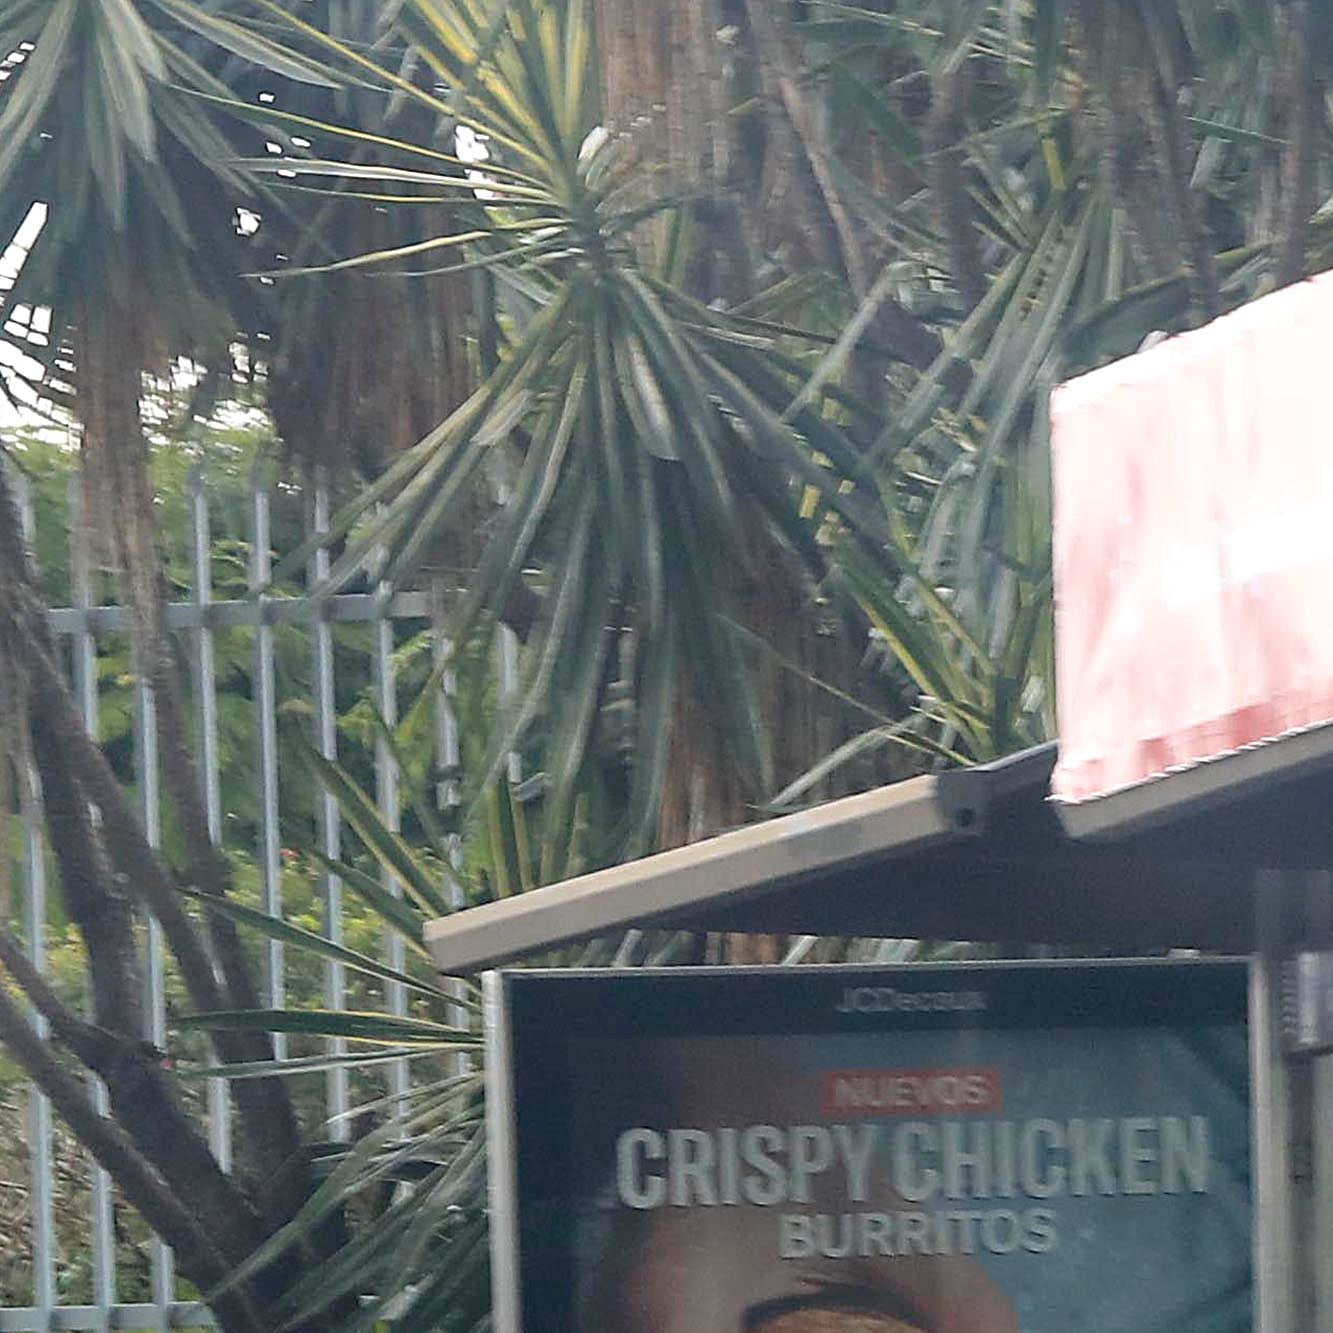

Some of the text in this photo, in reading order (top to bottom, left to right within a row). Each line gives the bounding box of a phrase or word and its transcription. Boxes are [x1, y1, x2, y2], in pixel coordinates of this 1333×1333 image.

[834, 1075, 988, 1108] NUEVOS
[616, 1115, 1211, 1209] CRISPY CHICKEN
[778, 1207, 1059, 1259] BURRITOS
